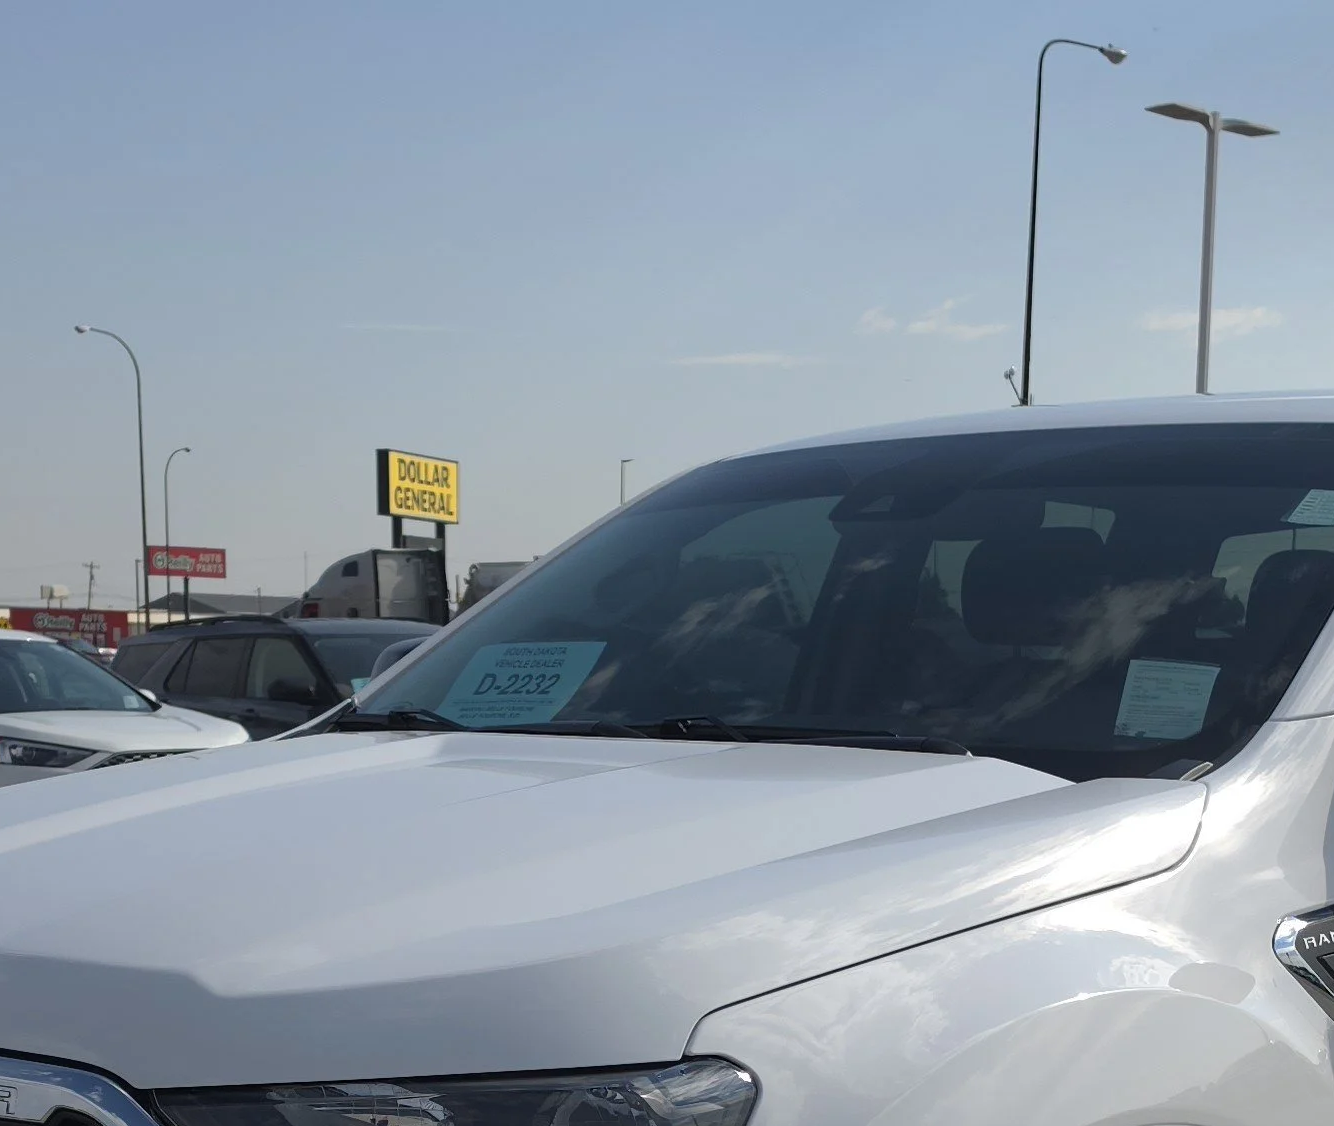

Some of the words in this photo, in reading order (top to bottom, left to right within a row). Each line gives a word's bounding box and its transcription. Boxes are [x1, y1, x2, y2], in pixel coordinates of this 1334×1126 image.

[397, 458, 451, 488] DOLLAR
[394, 486, 454, 515] GENERAL
[473, 673, 560, 695] D-2232
